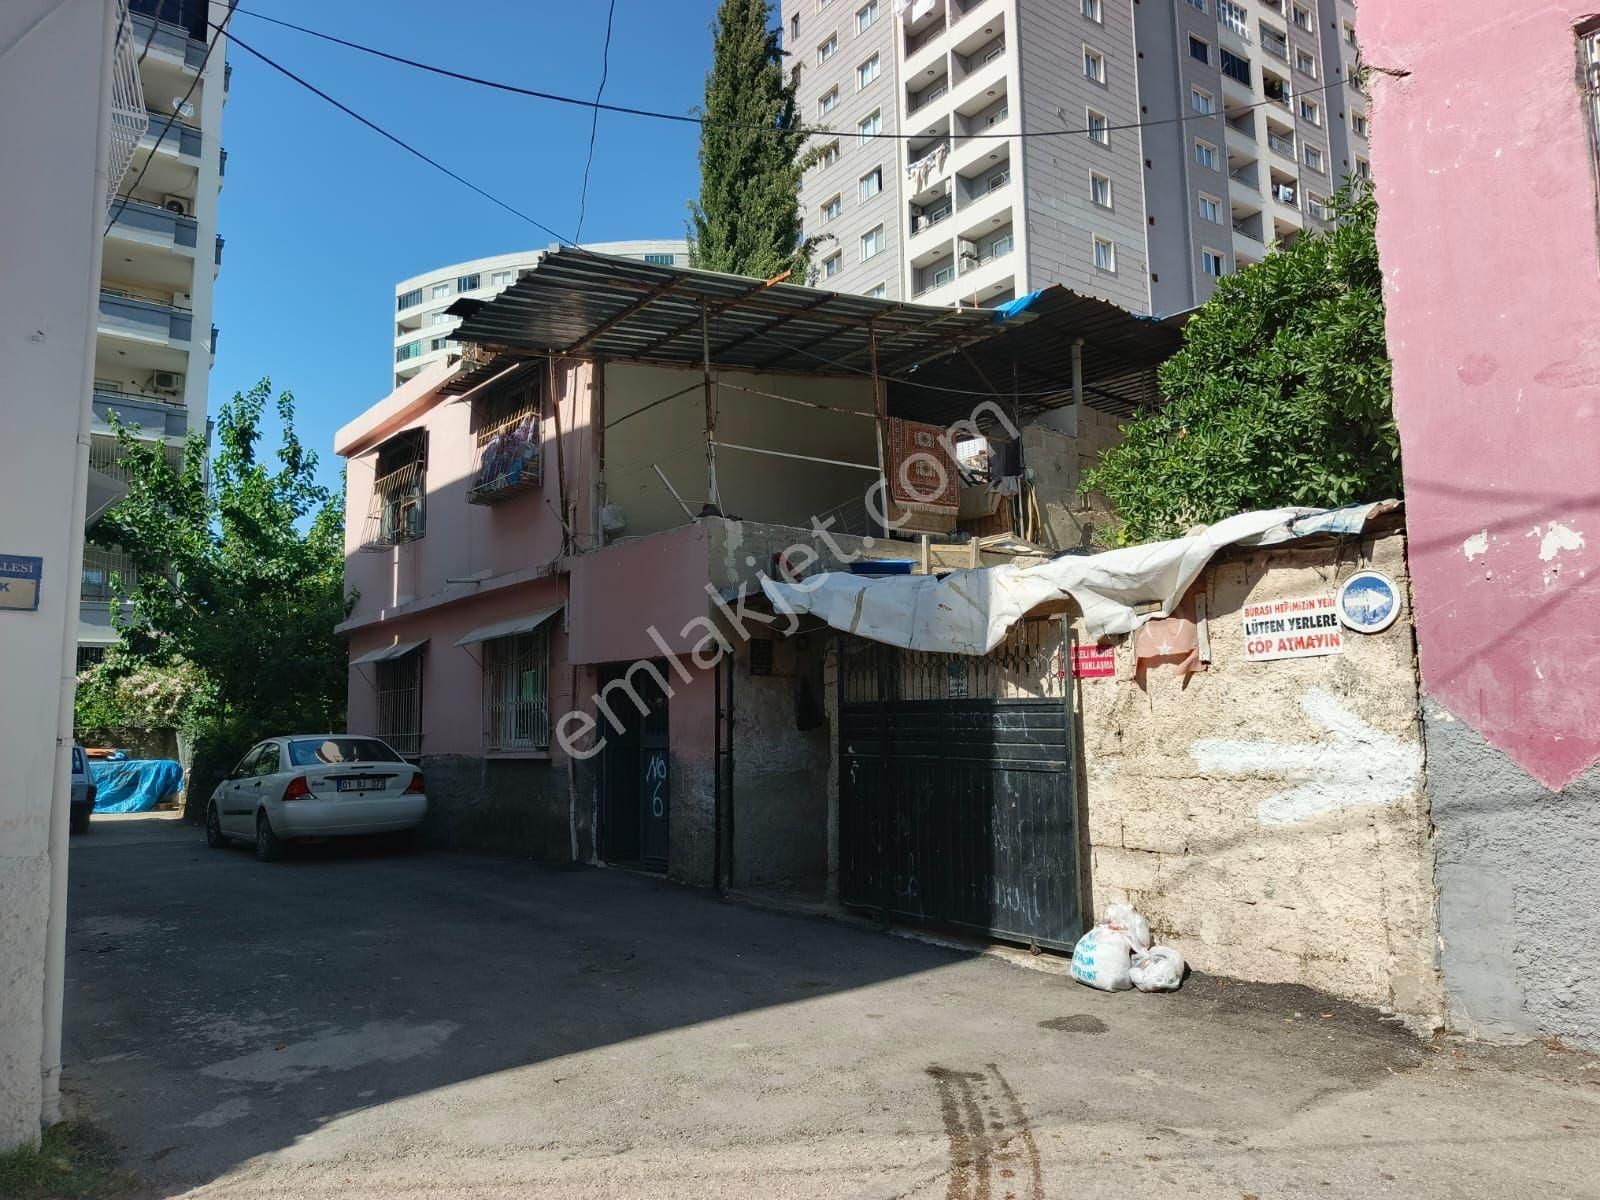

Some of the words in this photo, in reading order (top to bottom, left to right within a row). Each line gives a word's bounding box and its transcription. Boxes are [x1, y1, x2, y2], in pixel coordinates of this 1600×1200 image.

[1244, 605, 1272, 618] BURASI
[1245, 618, 1284, 636] LÜTFEN
[1287, 613, 1338, 630] YERLERE
[1247, 636, 1273, 656] ÇÖP
[1277, 633, 1341, 651] ATMAYIN
